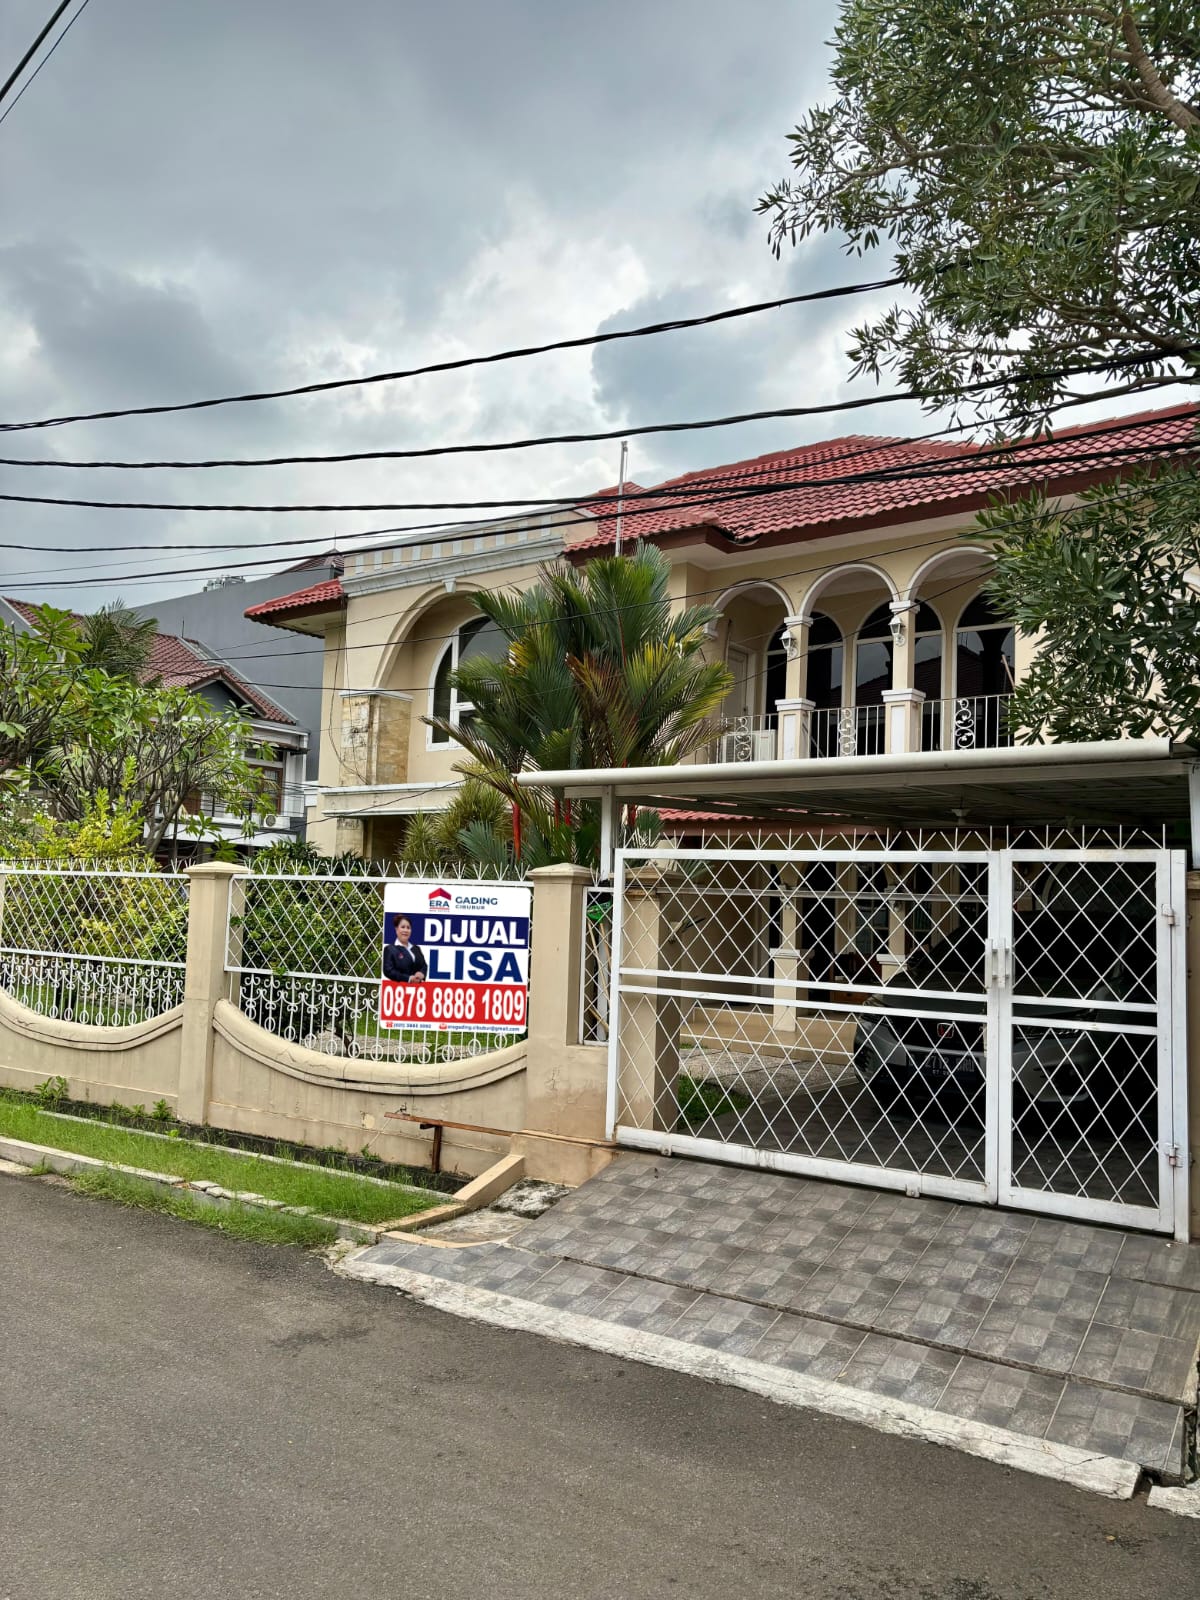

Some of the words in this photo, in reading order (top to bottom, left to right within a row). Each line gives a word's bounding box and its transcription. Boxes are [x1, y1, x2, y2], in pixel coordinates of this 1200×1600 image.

[429, 900, 450, 908] ERA
[455, 896, 498, 905] GADING
[423, 918, 526, 946] DIJUAL
[428, 949, 523, 982] LISA
[383, 985, 427, 1018] 0878
[431, 987, 476, 1020] 8888
[481, 988, 525, 1022] 1809
